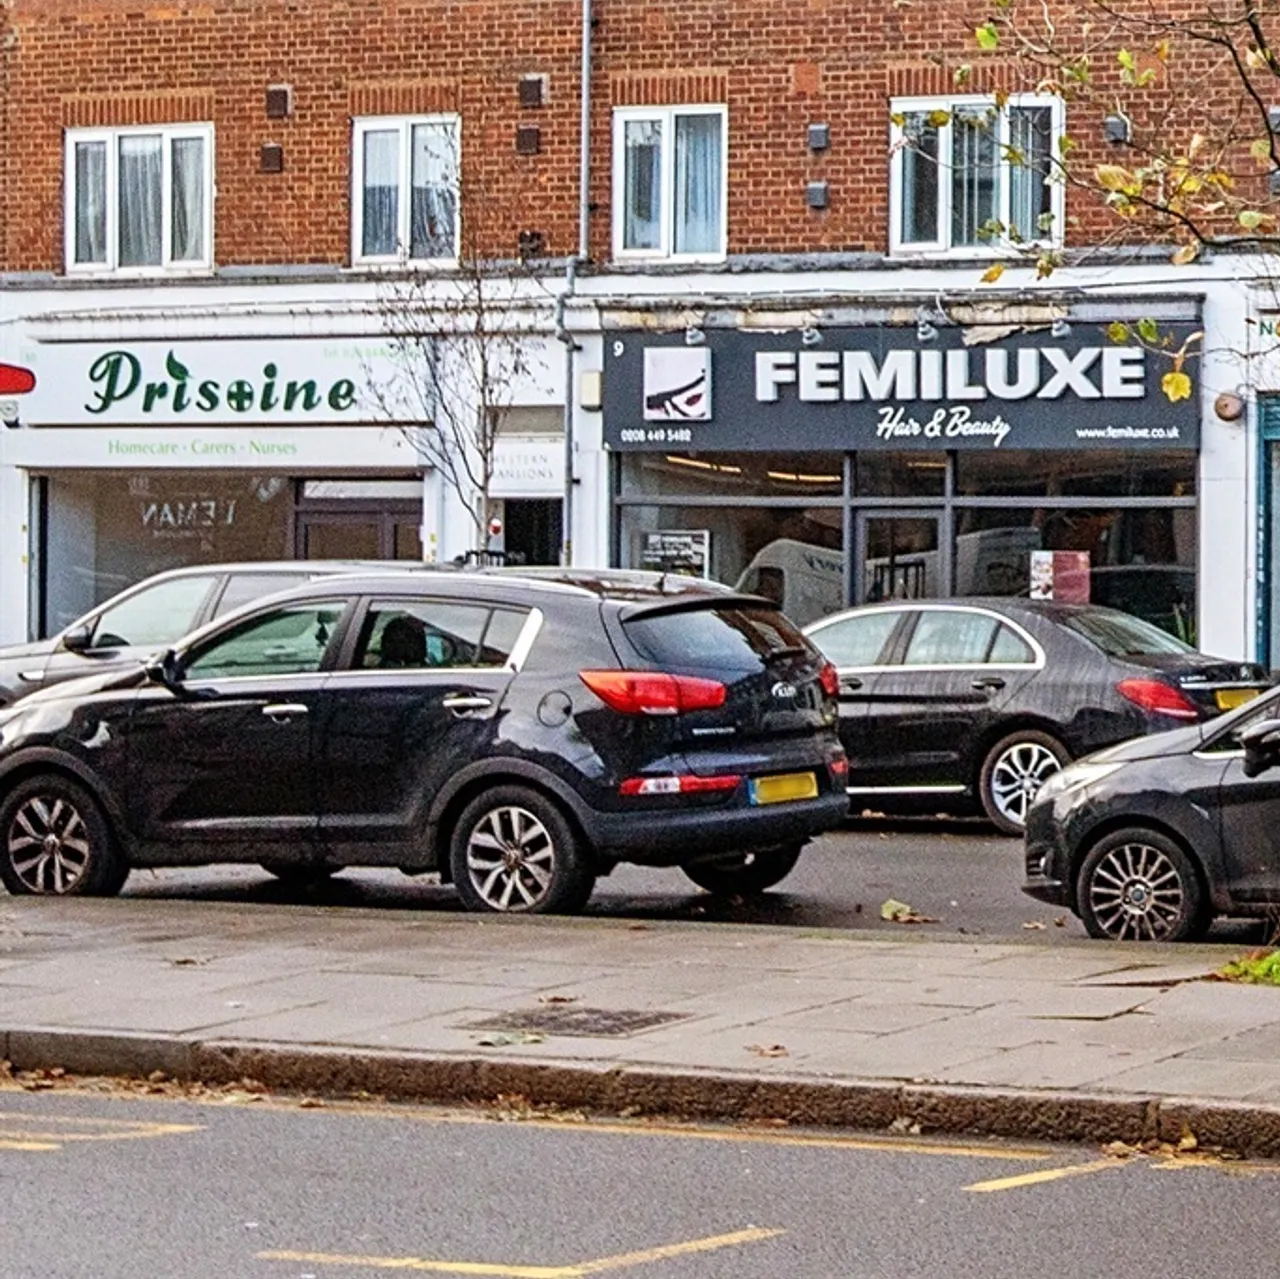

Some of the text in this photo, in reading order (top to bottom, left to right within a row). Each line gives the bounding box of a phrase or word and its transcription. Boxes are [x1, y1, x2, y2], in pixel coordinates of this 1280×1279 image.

[613, 341, 624, 357] 9
[755, 345, 1145, 403] FEMILUXE
[876, 406, 1012, 448] Hair & Beauty
[1075, 425, 1180, 440] www.femiluxe.co.uk
[108, 439, 298, 455] Homecare Carers Nurses
